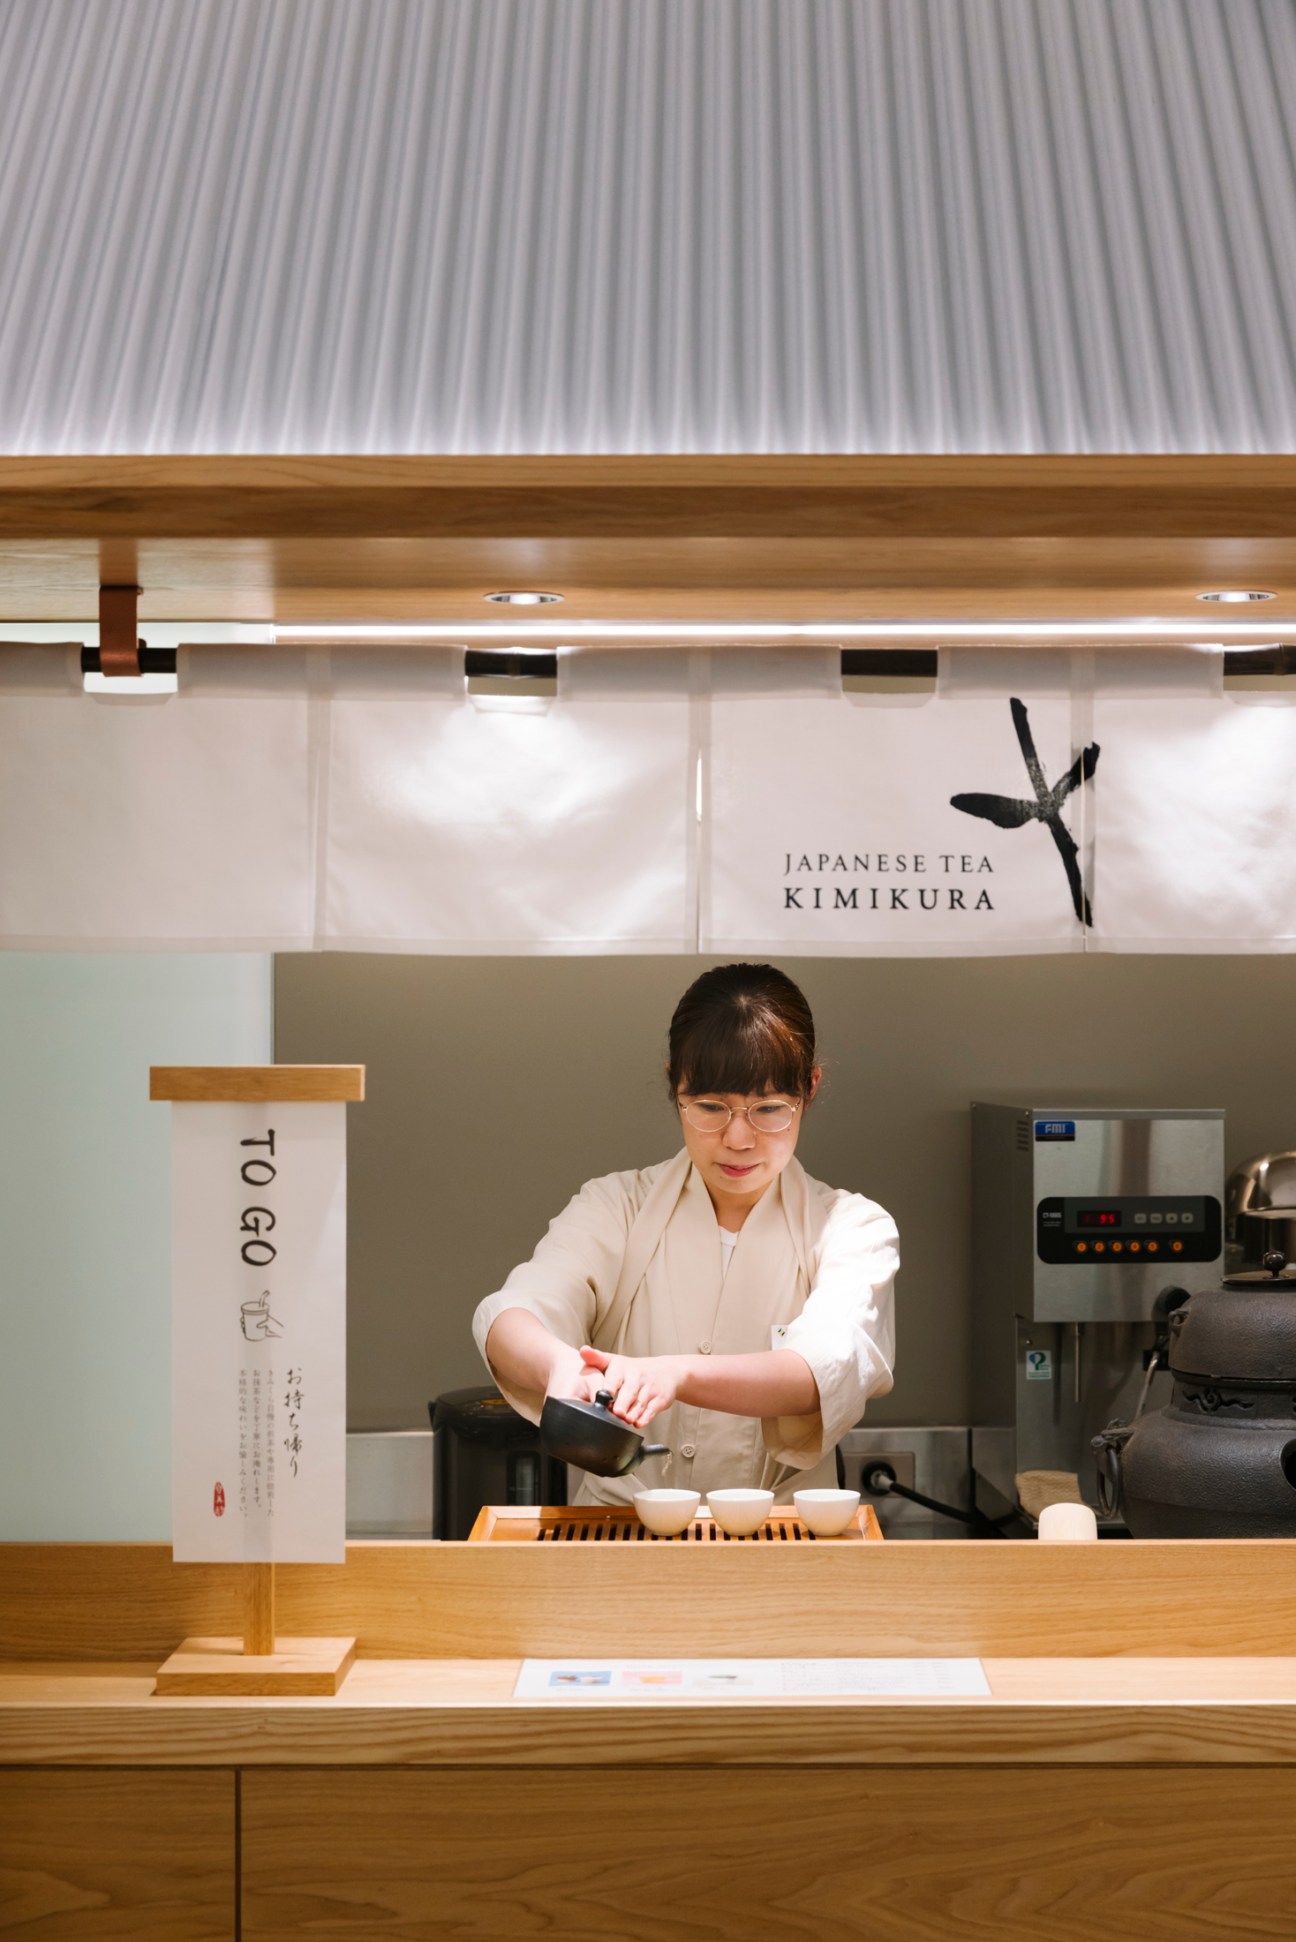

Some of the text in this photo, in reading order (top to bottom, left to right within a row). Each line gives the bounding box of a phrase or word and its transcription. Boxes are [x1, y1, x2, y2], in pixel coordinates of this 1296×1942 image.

[784, 853, 995, 876] JAPANESE TEA
[783, 887, 995, 910] KIMIKURA
[240, 1128, 277, 1266] TO GO
